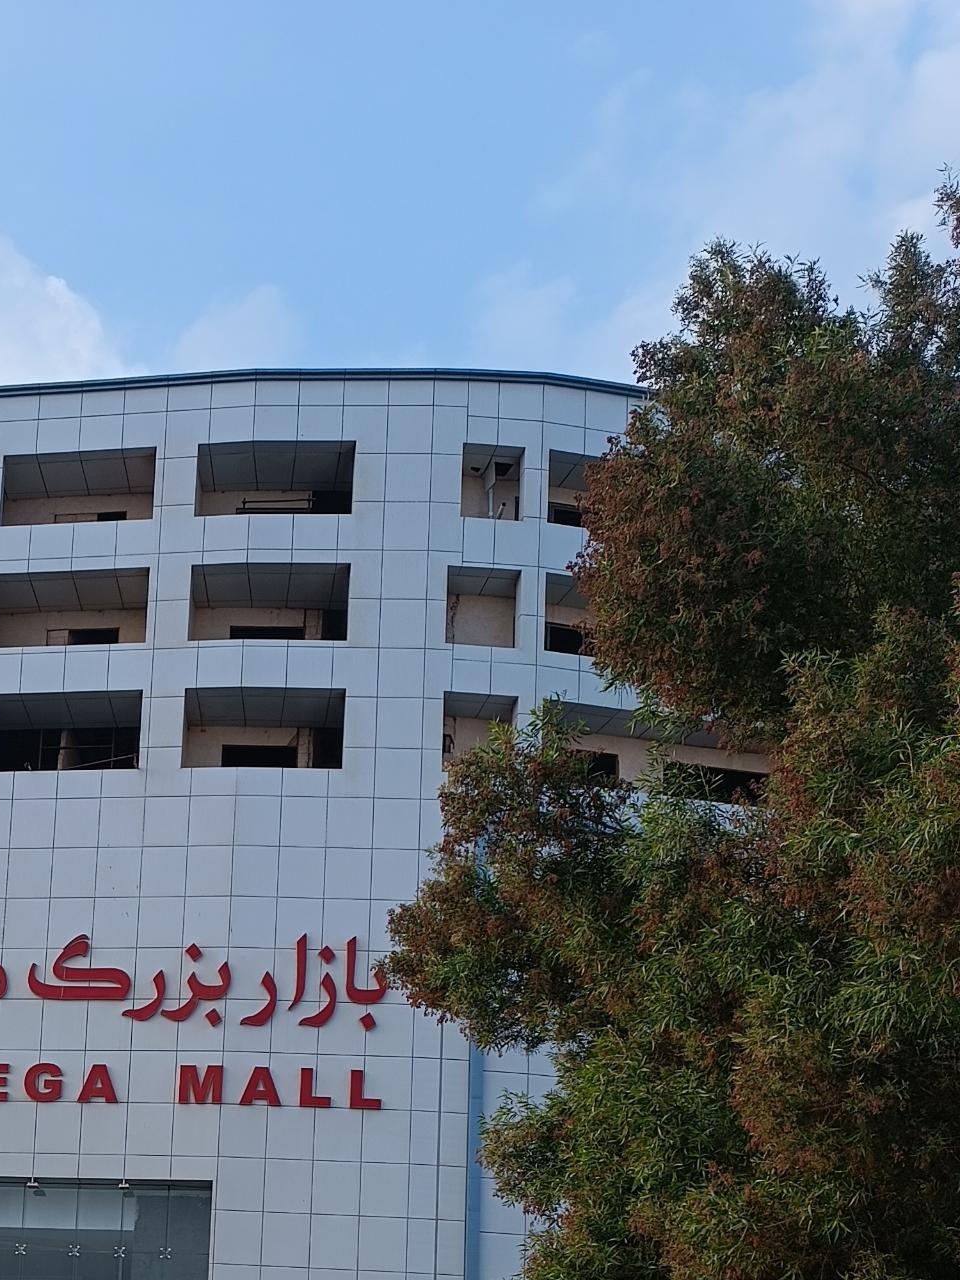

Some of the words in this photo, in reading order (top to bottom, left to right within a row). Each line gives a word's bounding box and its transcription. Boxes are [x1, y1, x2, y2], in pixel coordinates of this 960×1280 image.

[27, 933, 231, 1026] بزرگ
[240, 932, 388, 1031] بازار
[177, 1064, 383, 1111] MALL
